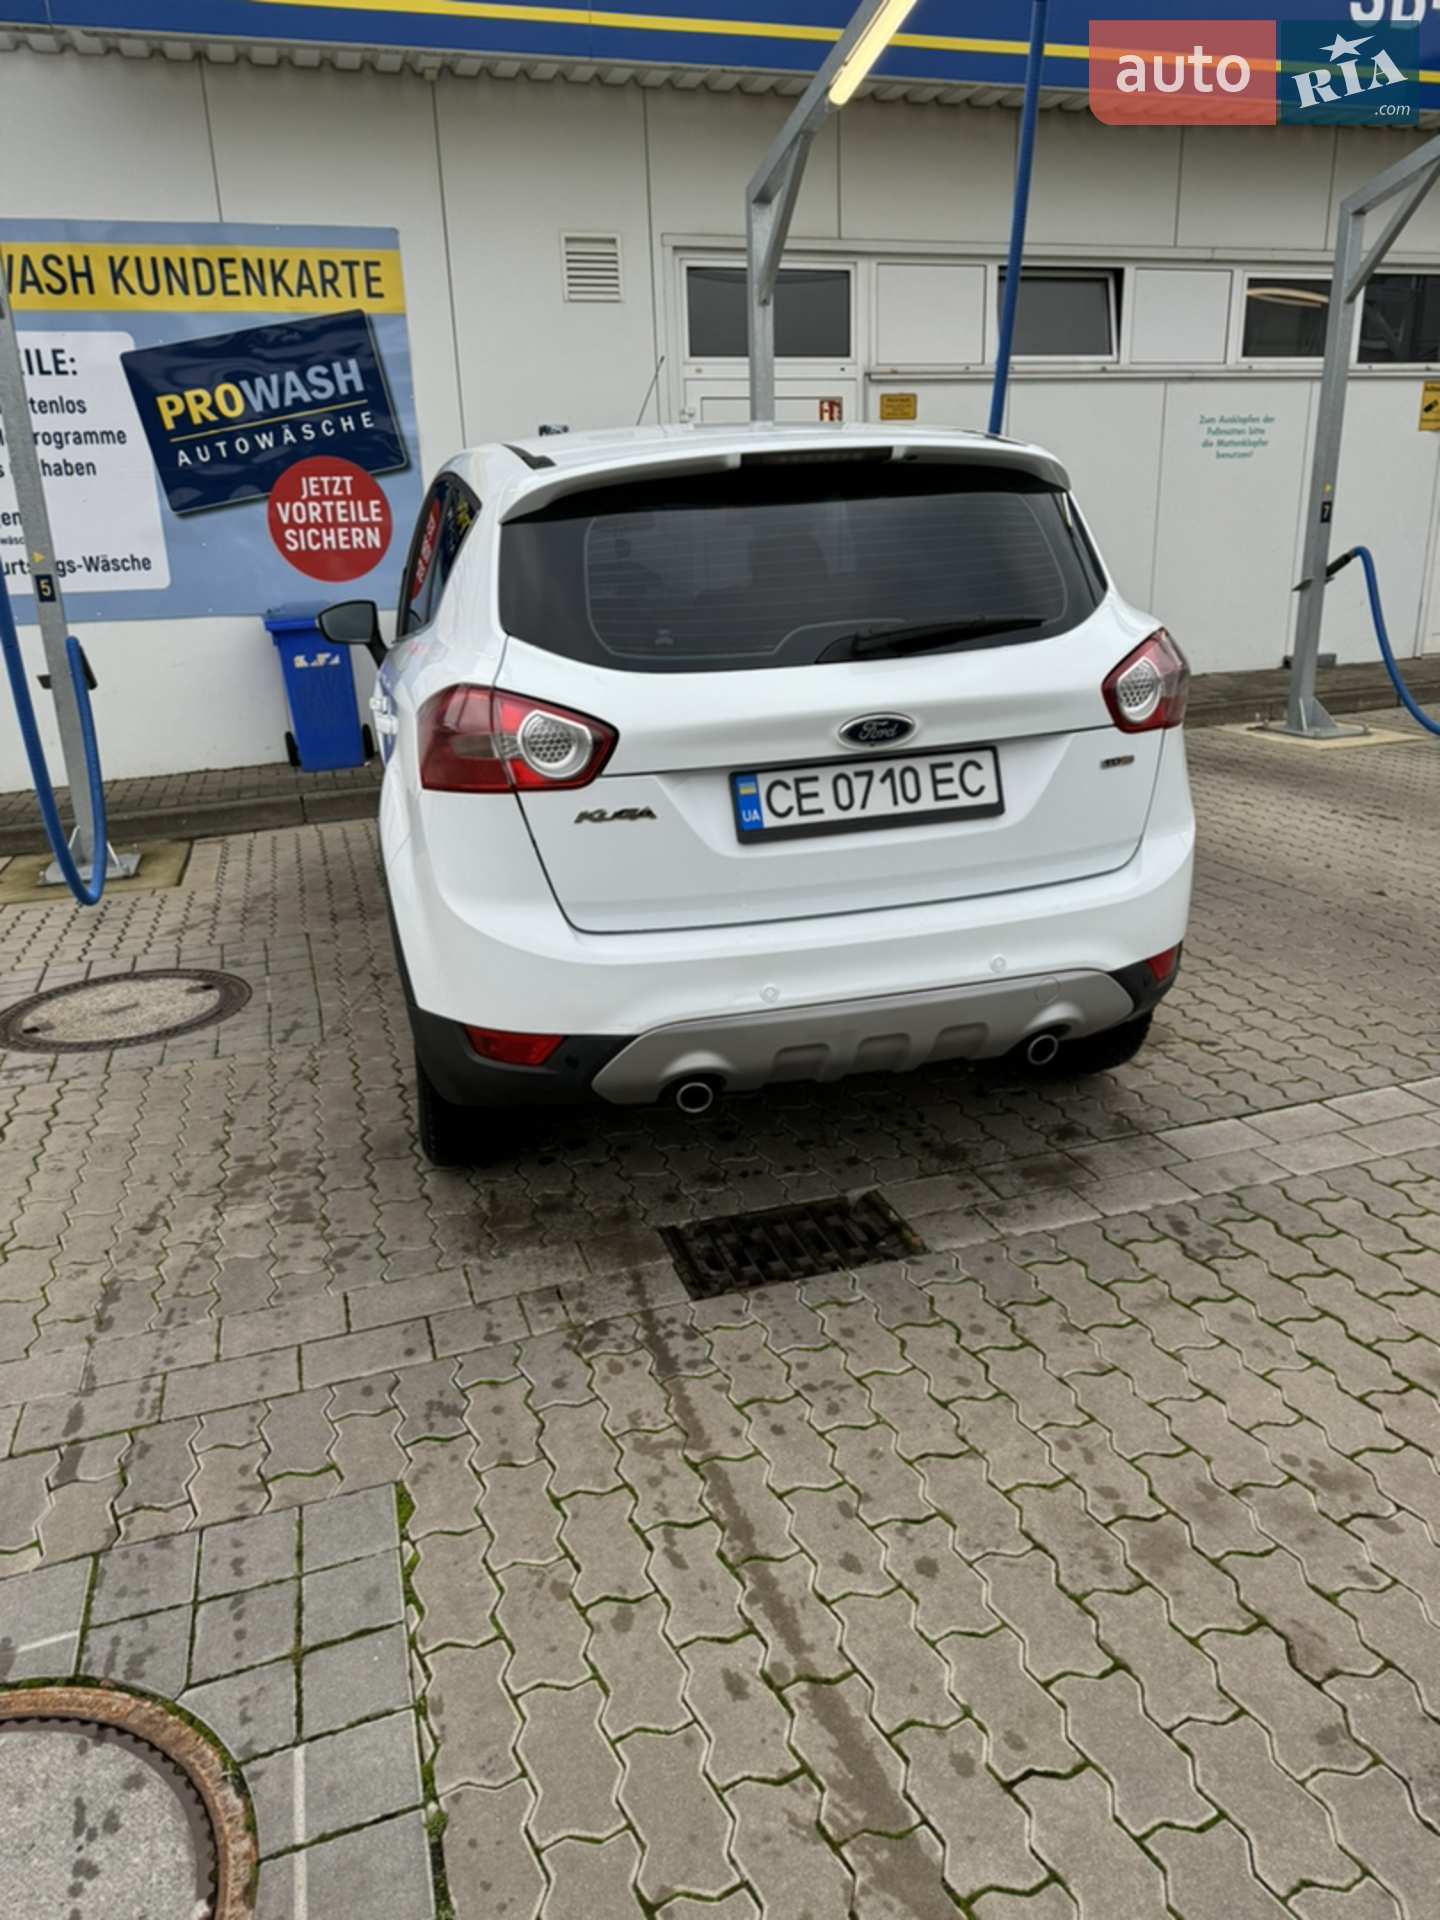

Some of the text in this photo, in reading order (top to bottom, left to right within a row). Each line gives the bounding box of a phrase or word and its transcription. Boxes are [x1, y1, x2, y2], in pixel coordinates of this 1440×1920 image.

[108, 254, 385, 299] KUNDENKARTE
[21, 347, 78, 376] ILE:
[29, 395, 87, 414] tenlos
[156, 358, 365, 430] PROWASH
[33, 429, 127, 449] rogramme
[177, 411, 375, 467] AUTOWÄSCHE
[300, 476, 353, 499] JETZT
[276, 500, 383, 524] VORTEILE
[284, 527, 382, 551] SICHERN
[39, 579, 52, 598] 5
[858, 720, 899, 740] Ford
[766, 758, 985, 819] CE 0710 EC
[574, 806, 657, 824] KUGA
[742, 808, 761, 821] UA
